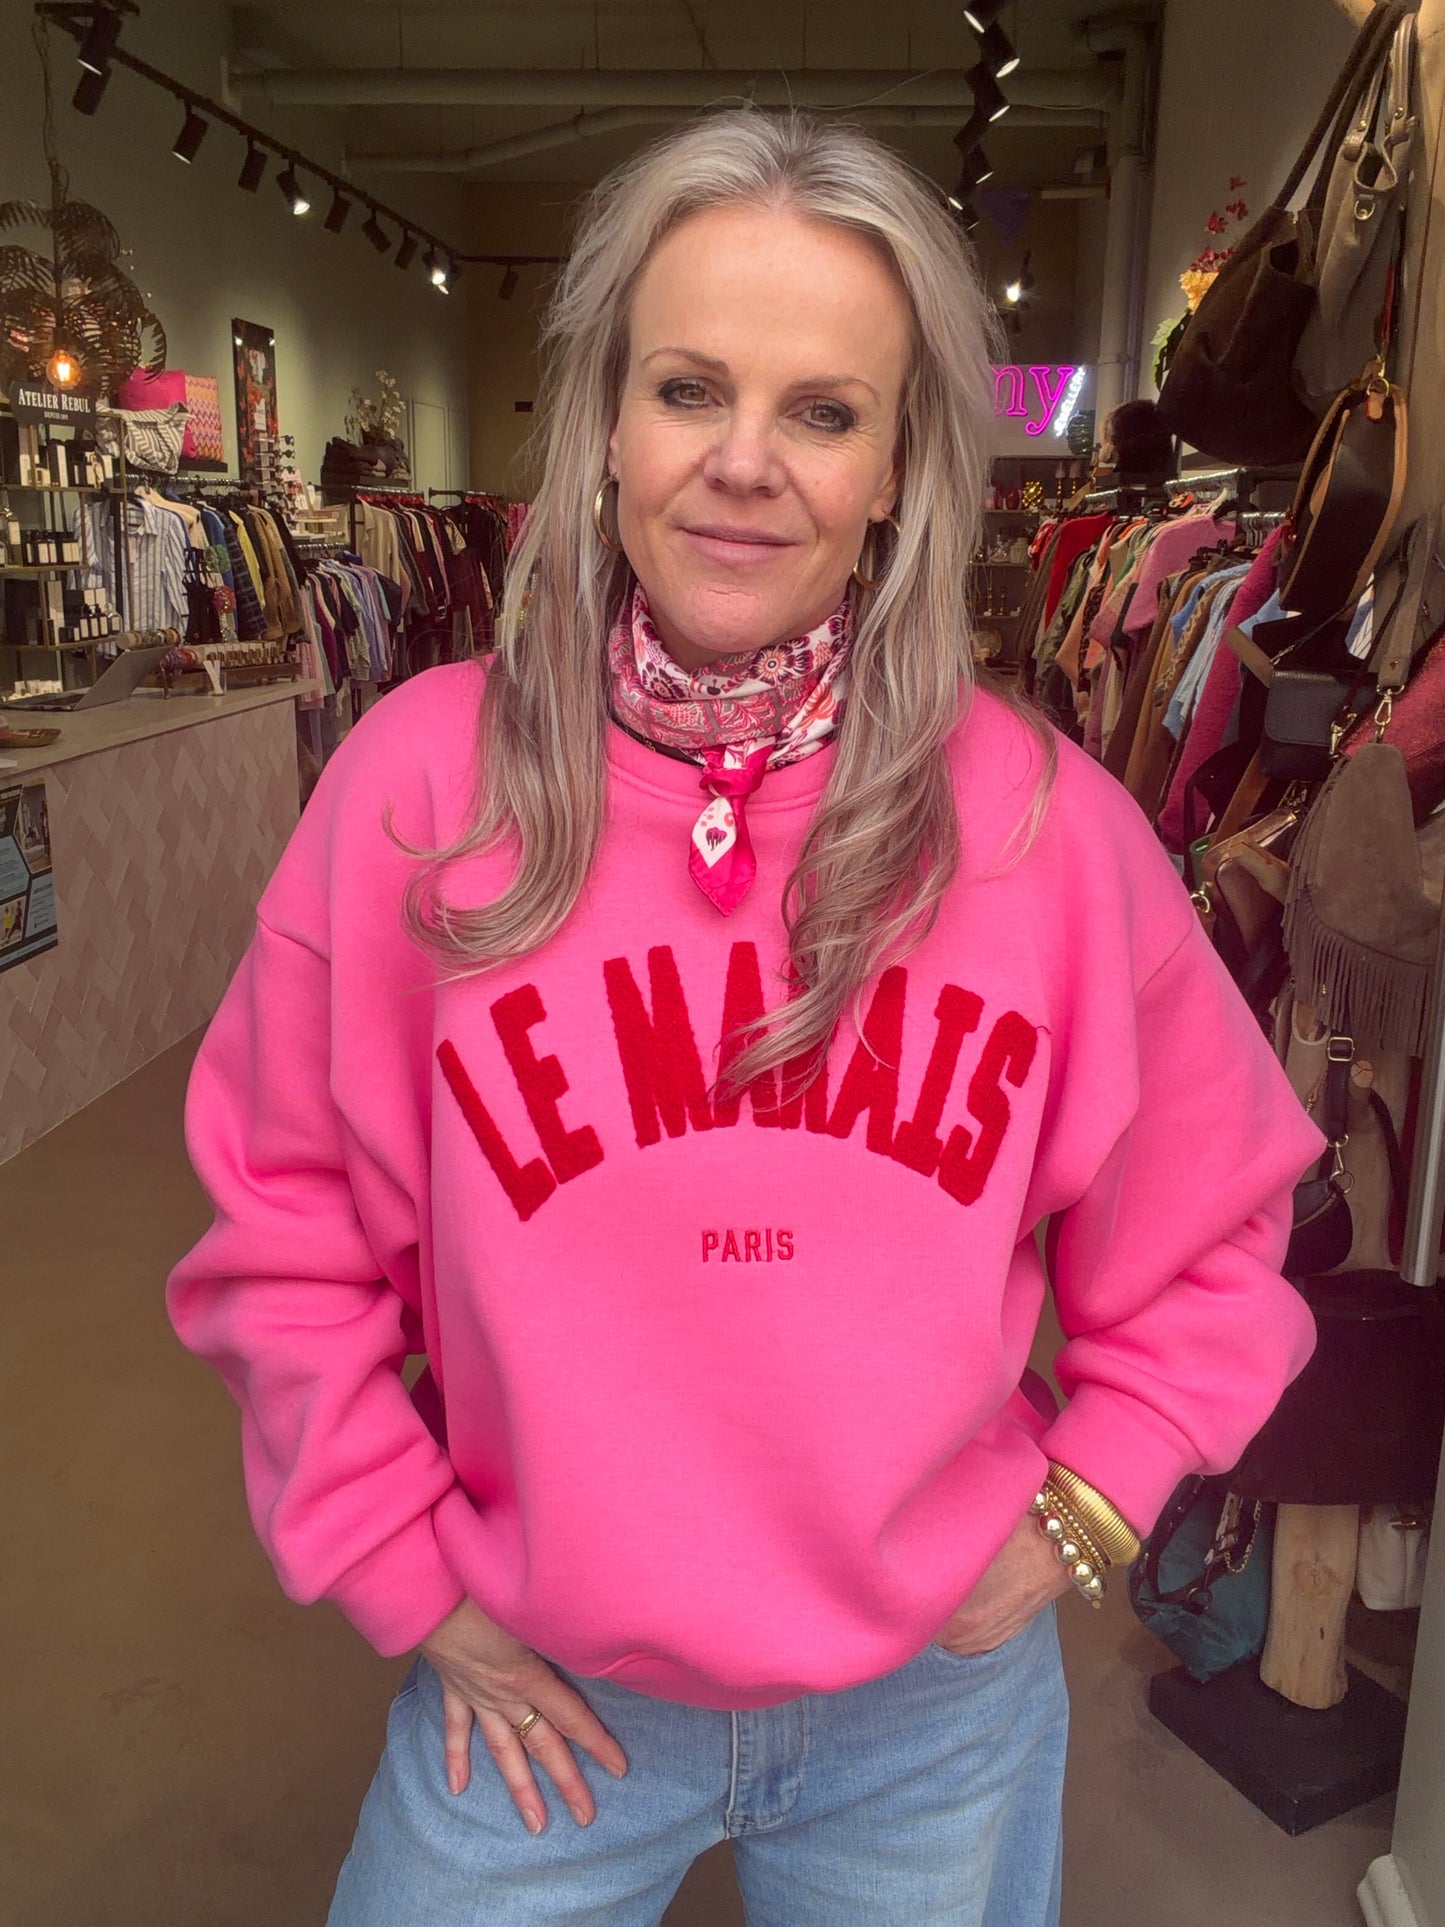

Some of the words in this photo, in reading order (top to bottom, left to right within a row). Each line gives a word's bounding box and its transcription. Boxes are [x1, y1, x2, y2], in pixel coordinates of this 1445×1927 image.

[18, 388, 59, 409] ATELIER
[61, 393, 91, 413] REBUL
[436, 983, 604, 1222] LE
[702, 1228, 794, 1263] PARIS
